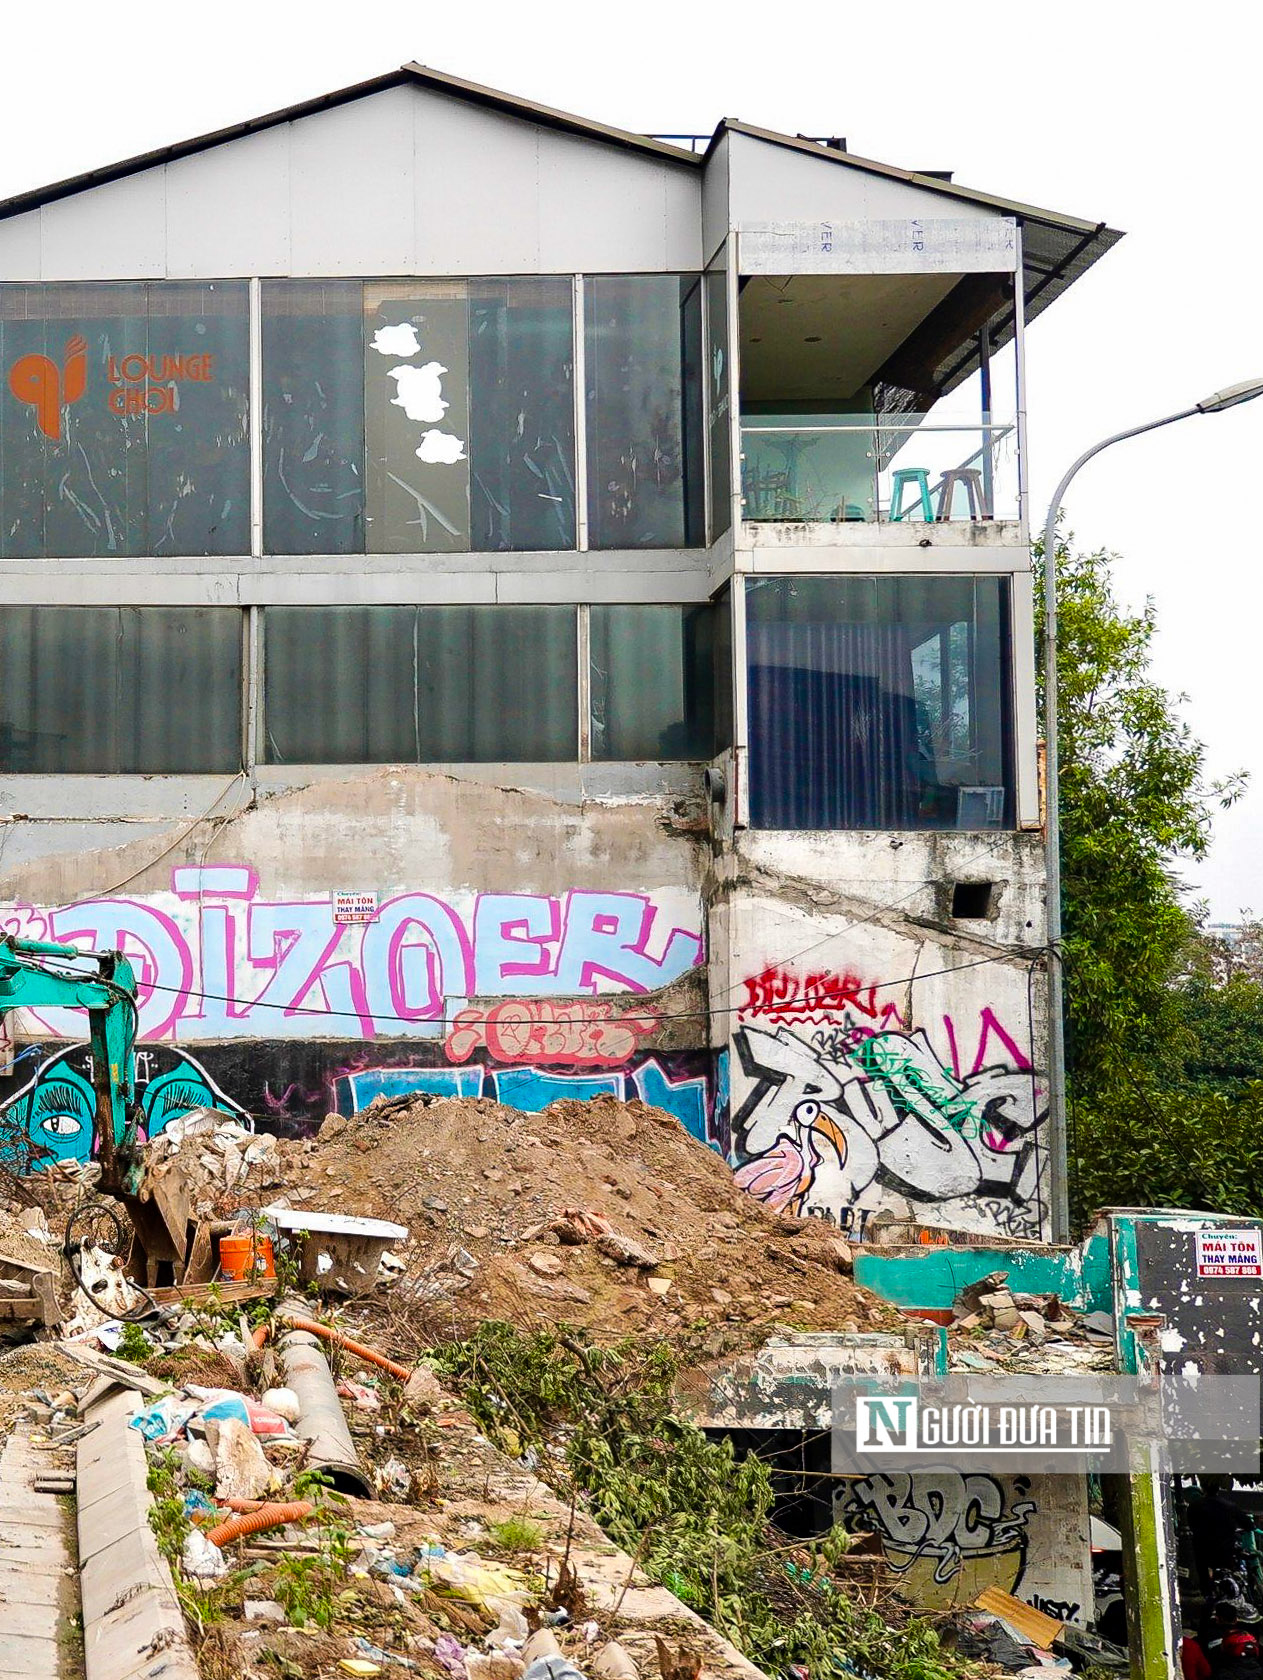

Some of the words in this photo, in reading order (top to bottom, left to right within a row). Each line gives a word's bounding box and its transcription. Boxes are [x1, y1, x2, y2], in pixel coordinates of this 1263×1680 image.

[107, 353, 215, 383] LOUNGE
[1230, 1240, 1255, 1252] TÔN
[1202, 1255, 1225, 1263] THAY
